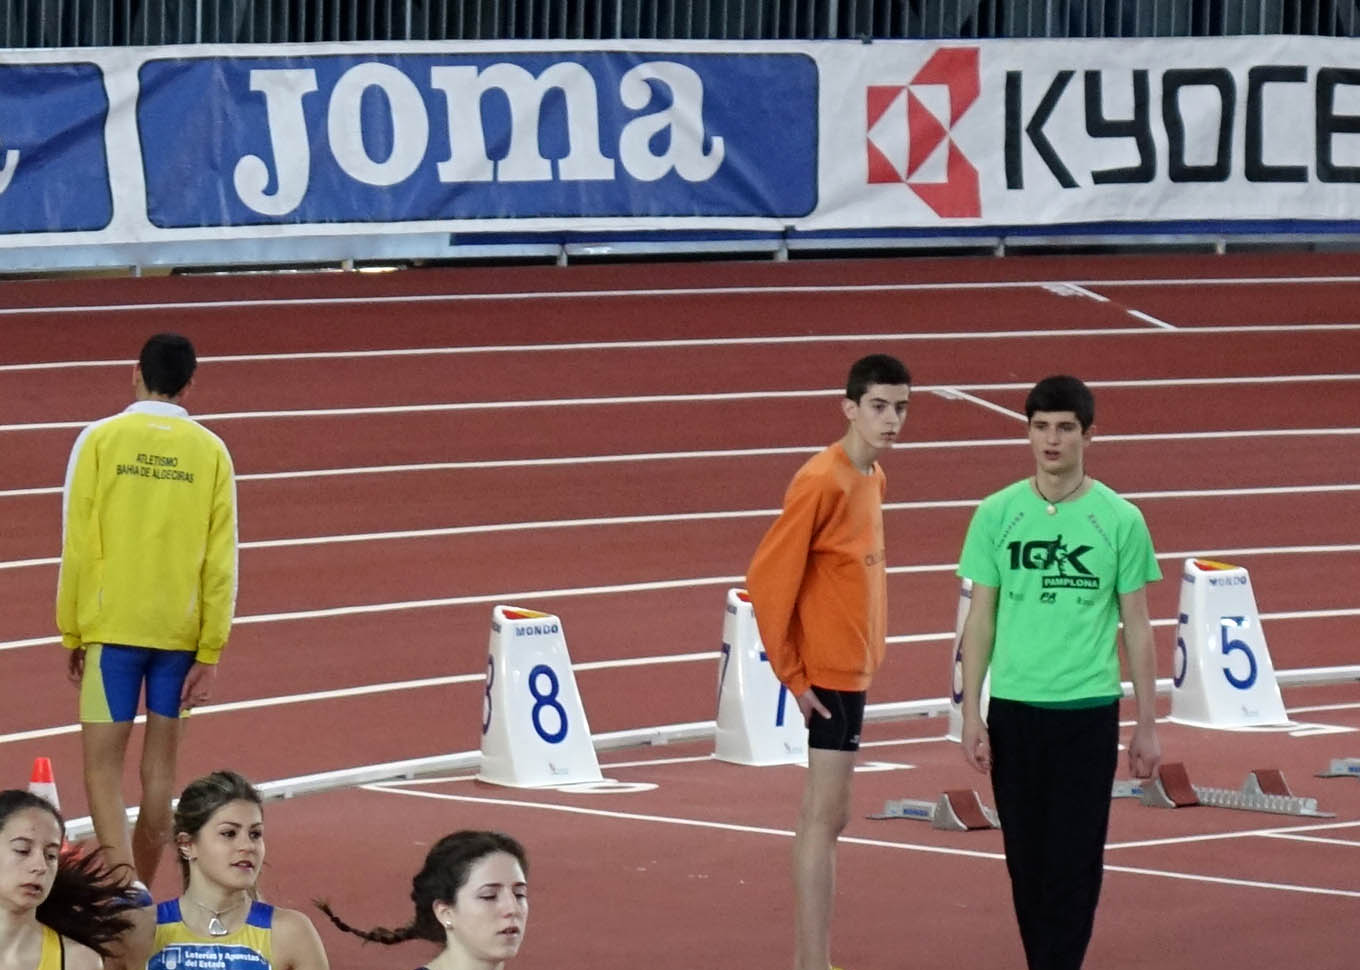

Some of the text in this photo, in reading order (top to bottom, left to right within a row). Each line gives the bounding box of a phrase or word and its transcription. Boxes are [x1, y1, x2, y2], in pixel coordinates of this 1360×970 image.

[1004, 65, 1360, 190] KYOCE
[1044, 578, 1099, 589] PAMPLONA
[515, 624, 559, 637] MONDO
[1220, 616, 1258, 690] 5
[528, 664, 569, 744] 8
